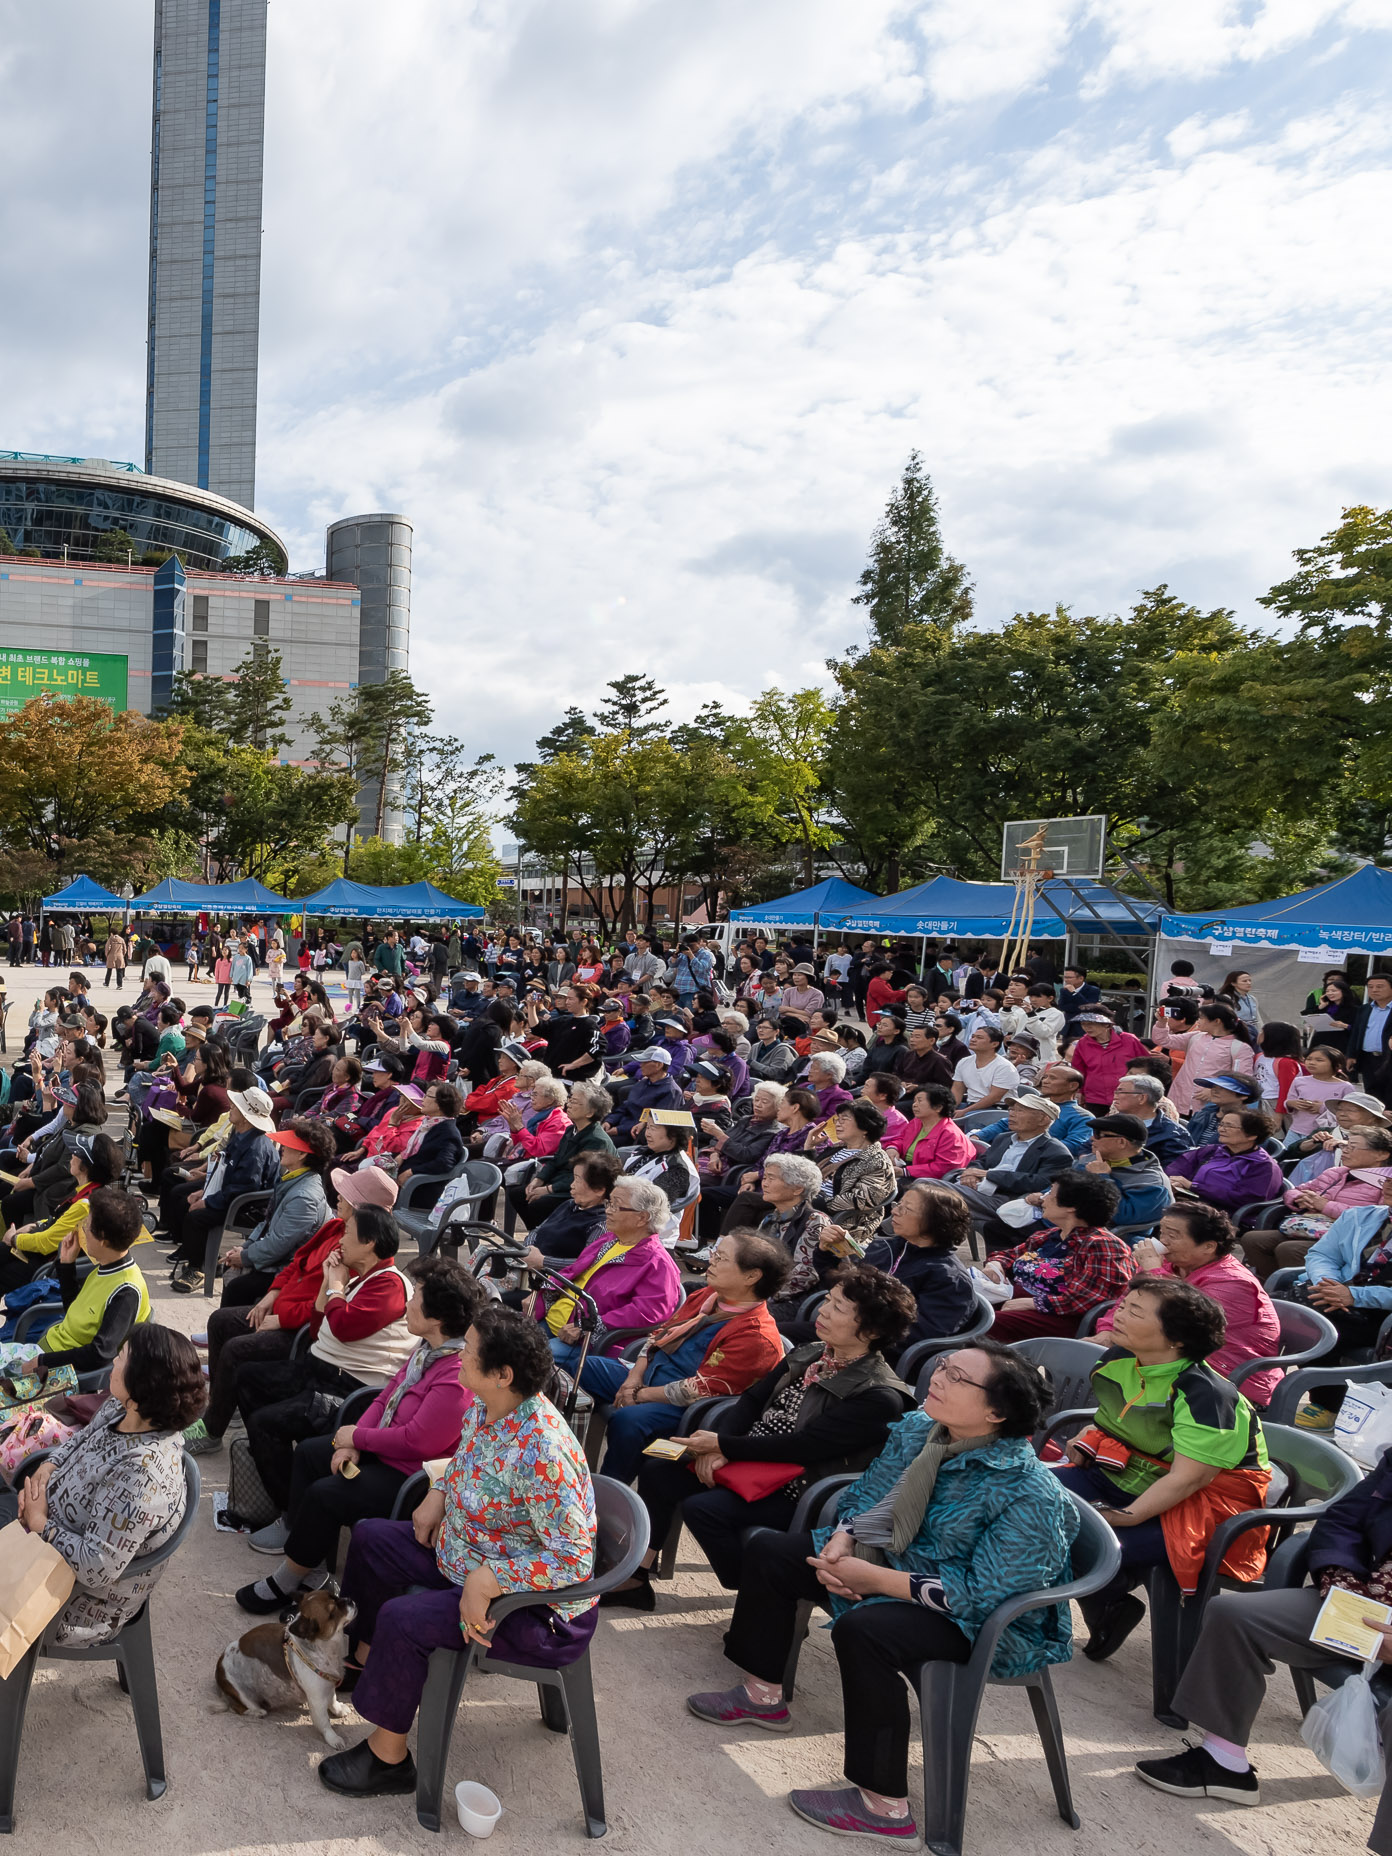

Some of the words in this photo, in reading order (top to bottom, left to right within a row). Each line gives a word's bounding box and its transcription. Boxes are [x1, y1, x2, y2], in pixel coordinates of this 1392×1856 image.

[9, 654, 24, 663] 최초
[25, 655, 49, 665] 브랜드
[50, 656, 66, 666] 복합
[67, 657, 90, 667] 쇼핑몰
[17, 666, 101, 688] 테크노마트
[845, 919, 880, 928] 구삼열린축제
[916, 920, 958, 931] 솟대만들기
[1212, 925, 1279, 940] 구삼열린축제
